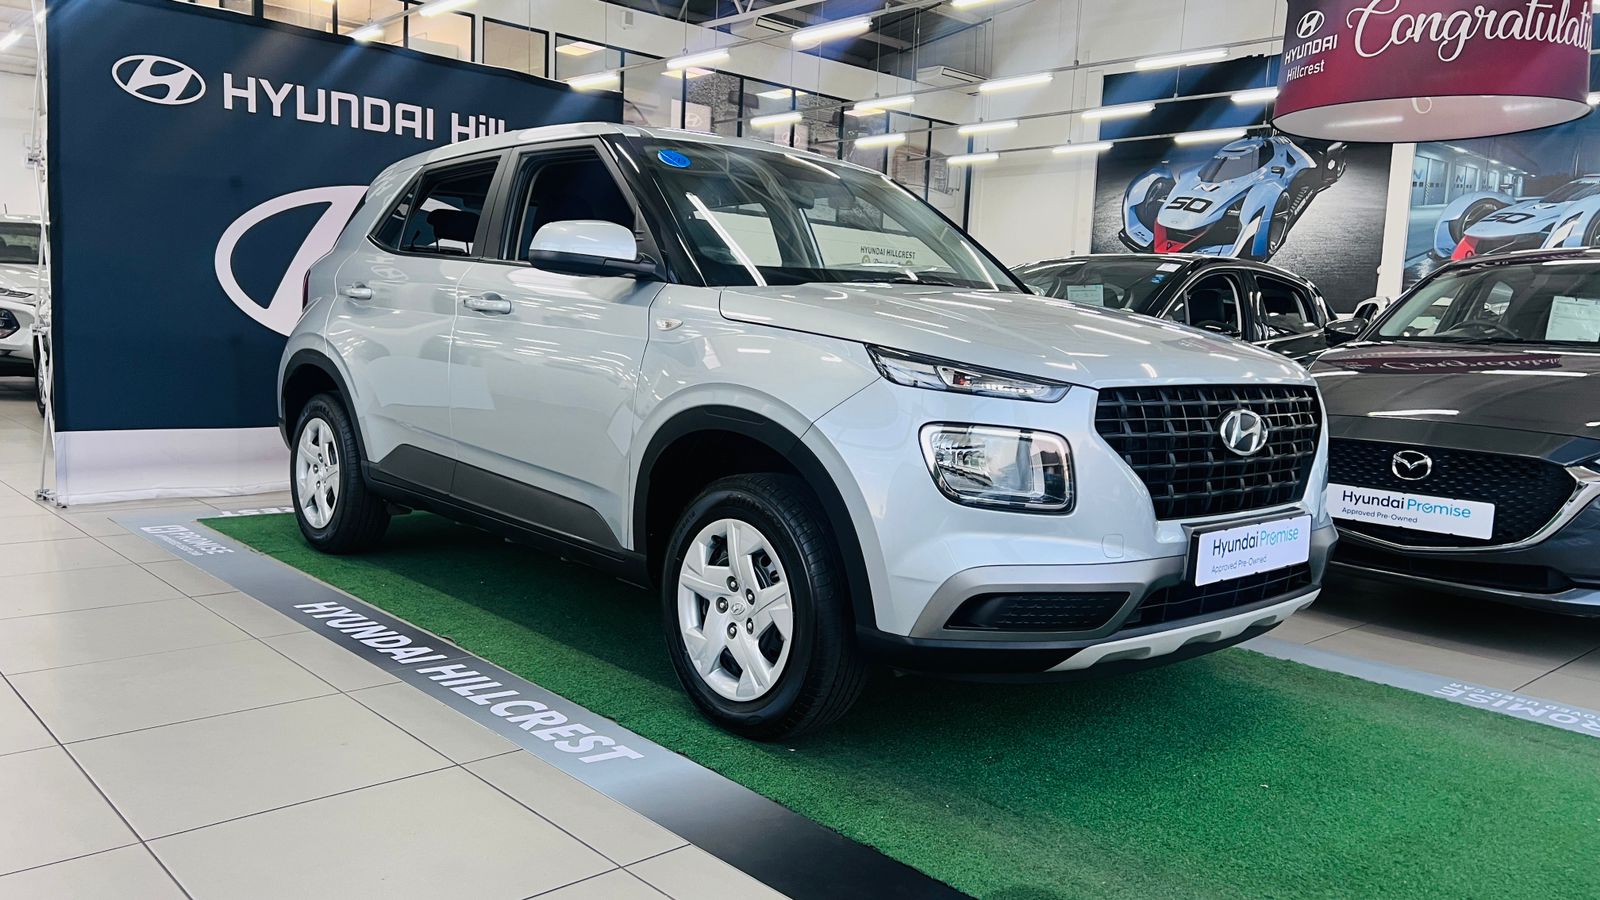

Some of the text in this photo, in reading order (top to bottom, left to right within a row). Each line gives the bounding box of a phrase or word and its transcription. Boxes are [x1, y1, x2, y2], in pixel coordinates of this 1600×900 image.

[1285, 34, 1338, 65] HYUNDAI
[1286, 59, 1325, 83] Hillcrest
[223, 72, 434, 141] HYUNDAI
[1165, 196, 1214, 214] 50
[860, 246, 916, 259] HYUNDAI HILLCREST
[1341, 506, 1418, 524] Approved Pre-Owned
[1342, 490, 1472, 519] Hyundai Promise
[1212, 526, 1299, 558] Hyundai Promise
[1211, 554, 1267, 575] Approved Pre-Owned
[294, 601, 645, 764] HYUNDAI HILLCREST
